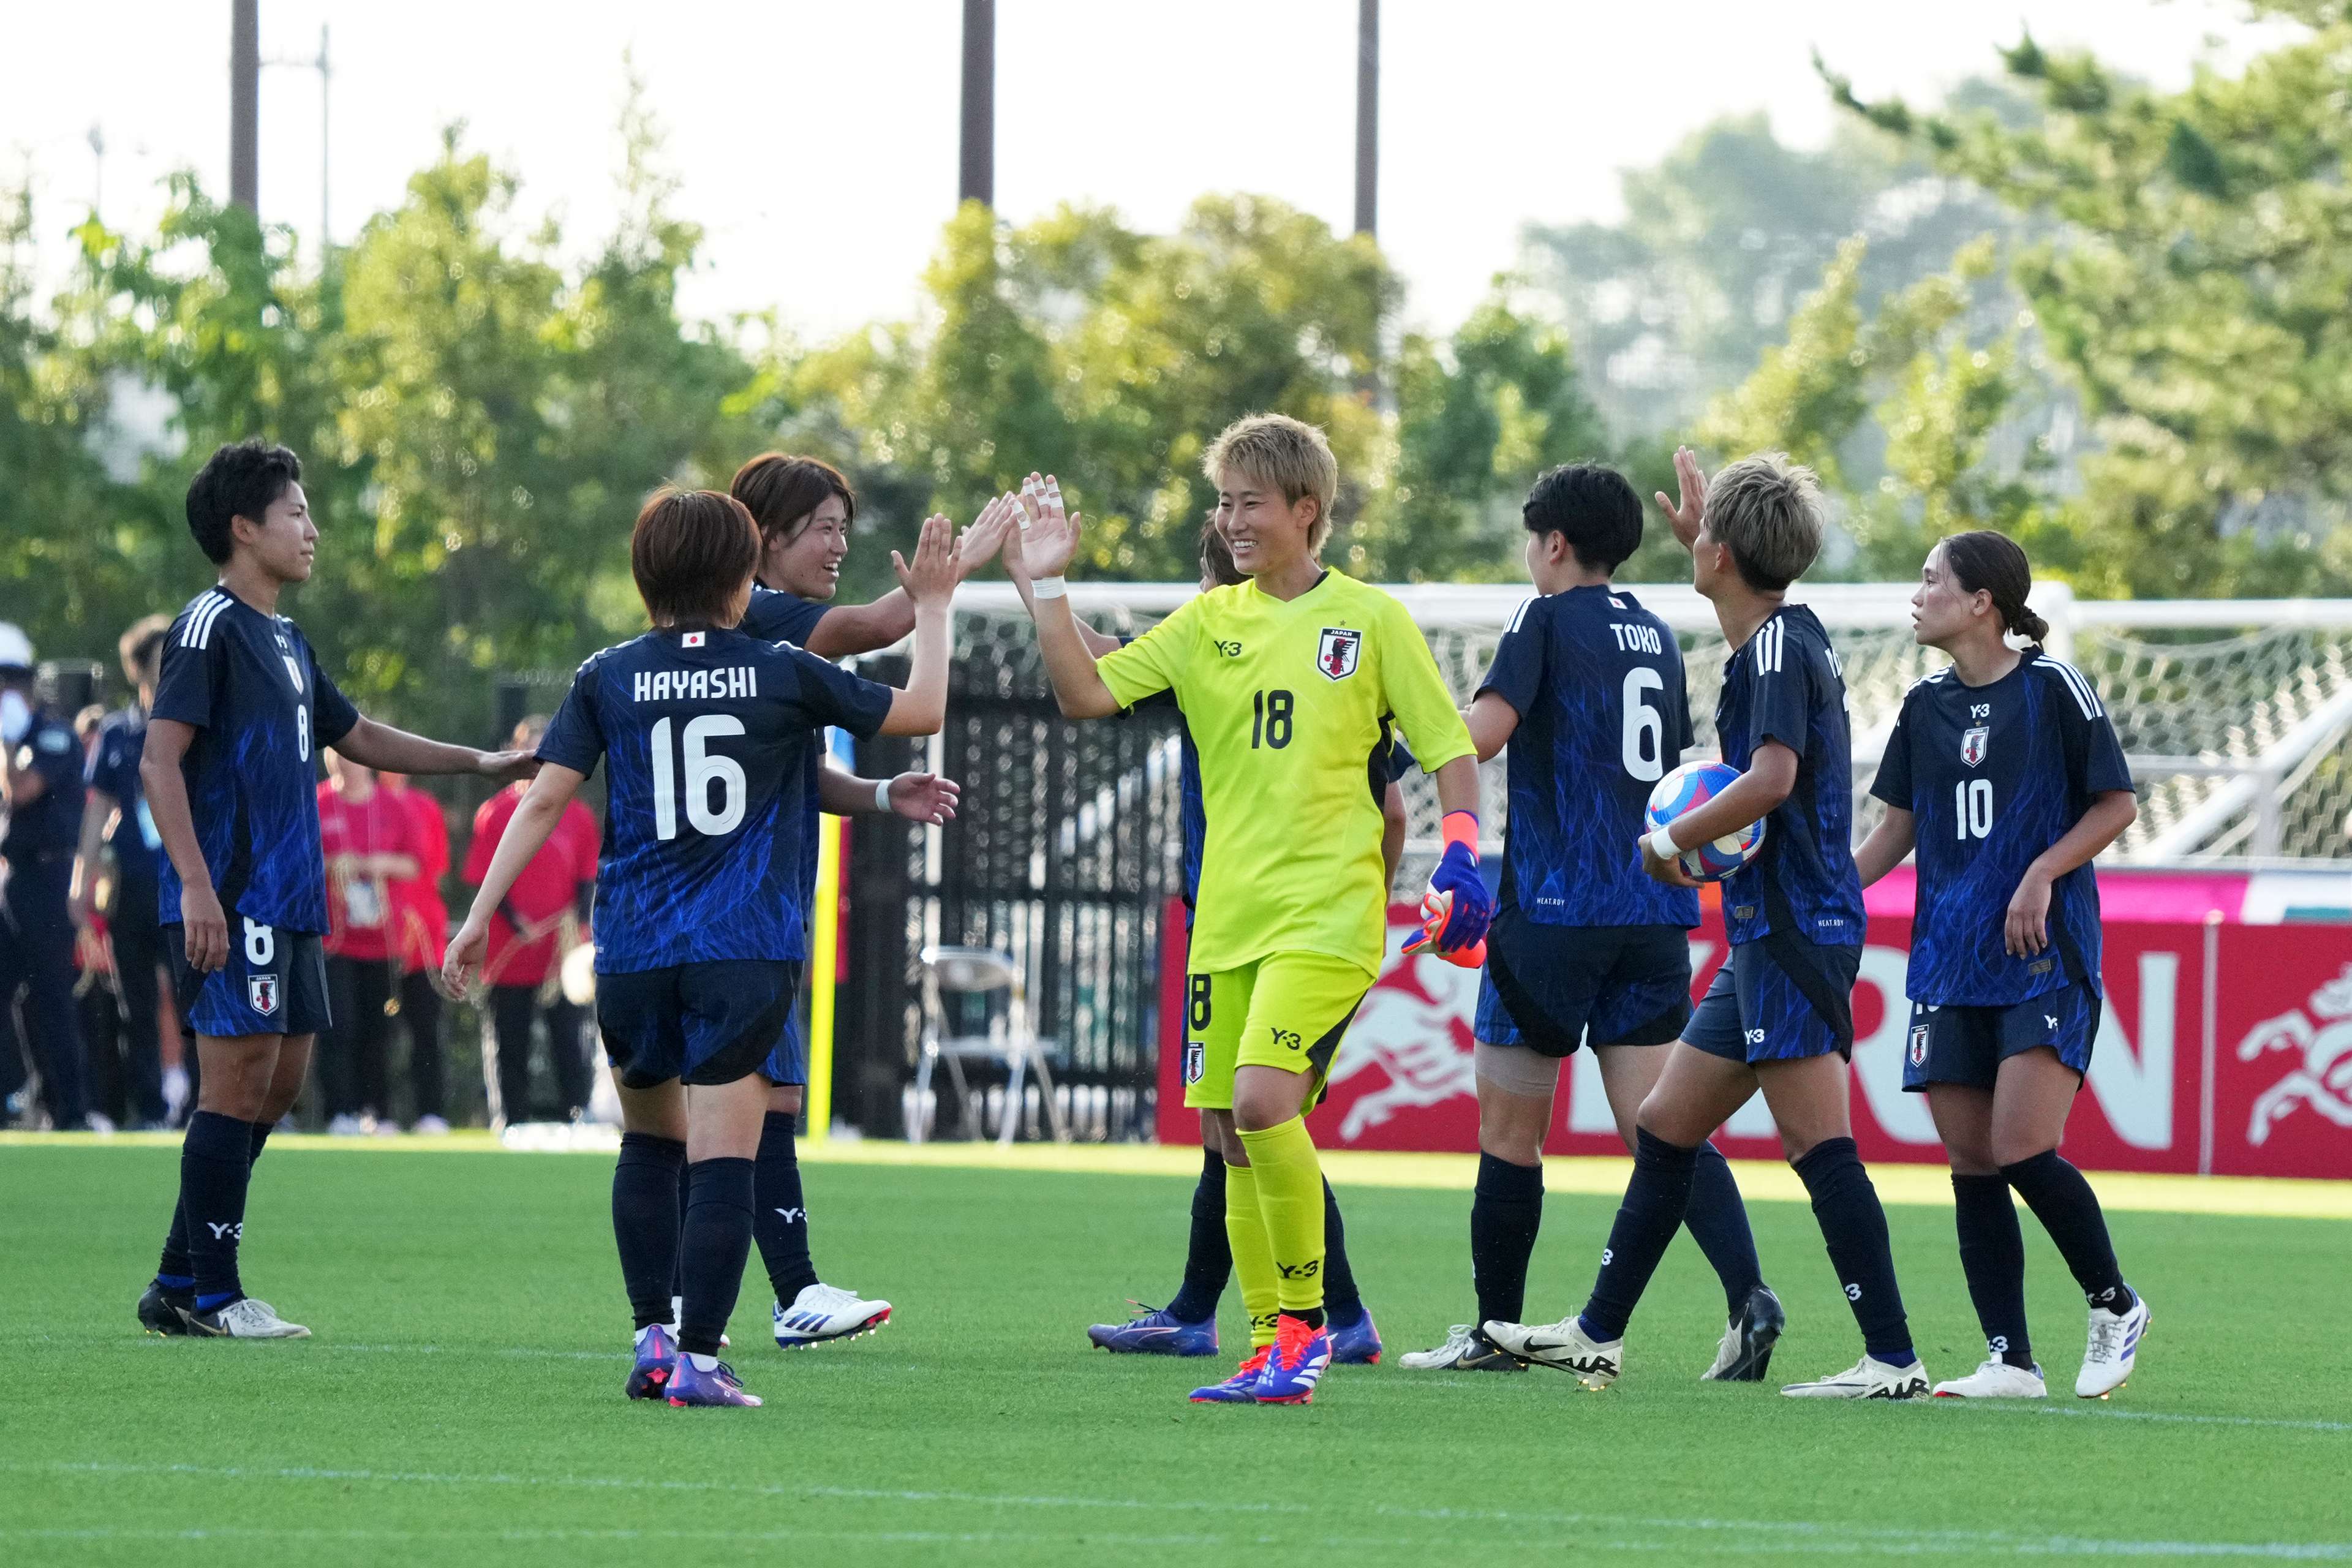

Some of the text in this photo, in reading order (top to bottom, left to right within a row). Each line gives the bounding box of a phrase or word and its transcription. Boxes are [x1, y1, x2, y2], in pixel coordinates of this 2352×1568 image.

[1214, 641, 1242, 657] Y-3
[1609, 624, 1662, 655] TOKO
[635, 667, 757, 702] HAYASHI
[1251, 690, 1294, 749] 18
[1623, 667, 1664, 782] 6
[1970, 703, 1990, 718] Y-3
[298, 704, 309, 763] 8
[650, 714, 747, 841] 16
[1956, 778, 1993, 840] 10
[243, 916, 275, 966] 8
[1190, 974, 1212, 1031] 8
[1270, 1027, 1302, 1050] Y-3
[1744, 1028, 1765, 1045] Y-3
[1276, 1260, 1319, 1279] Y-3
